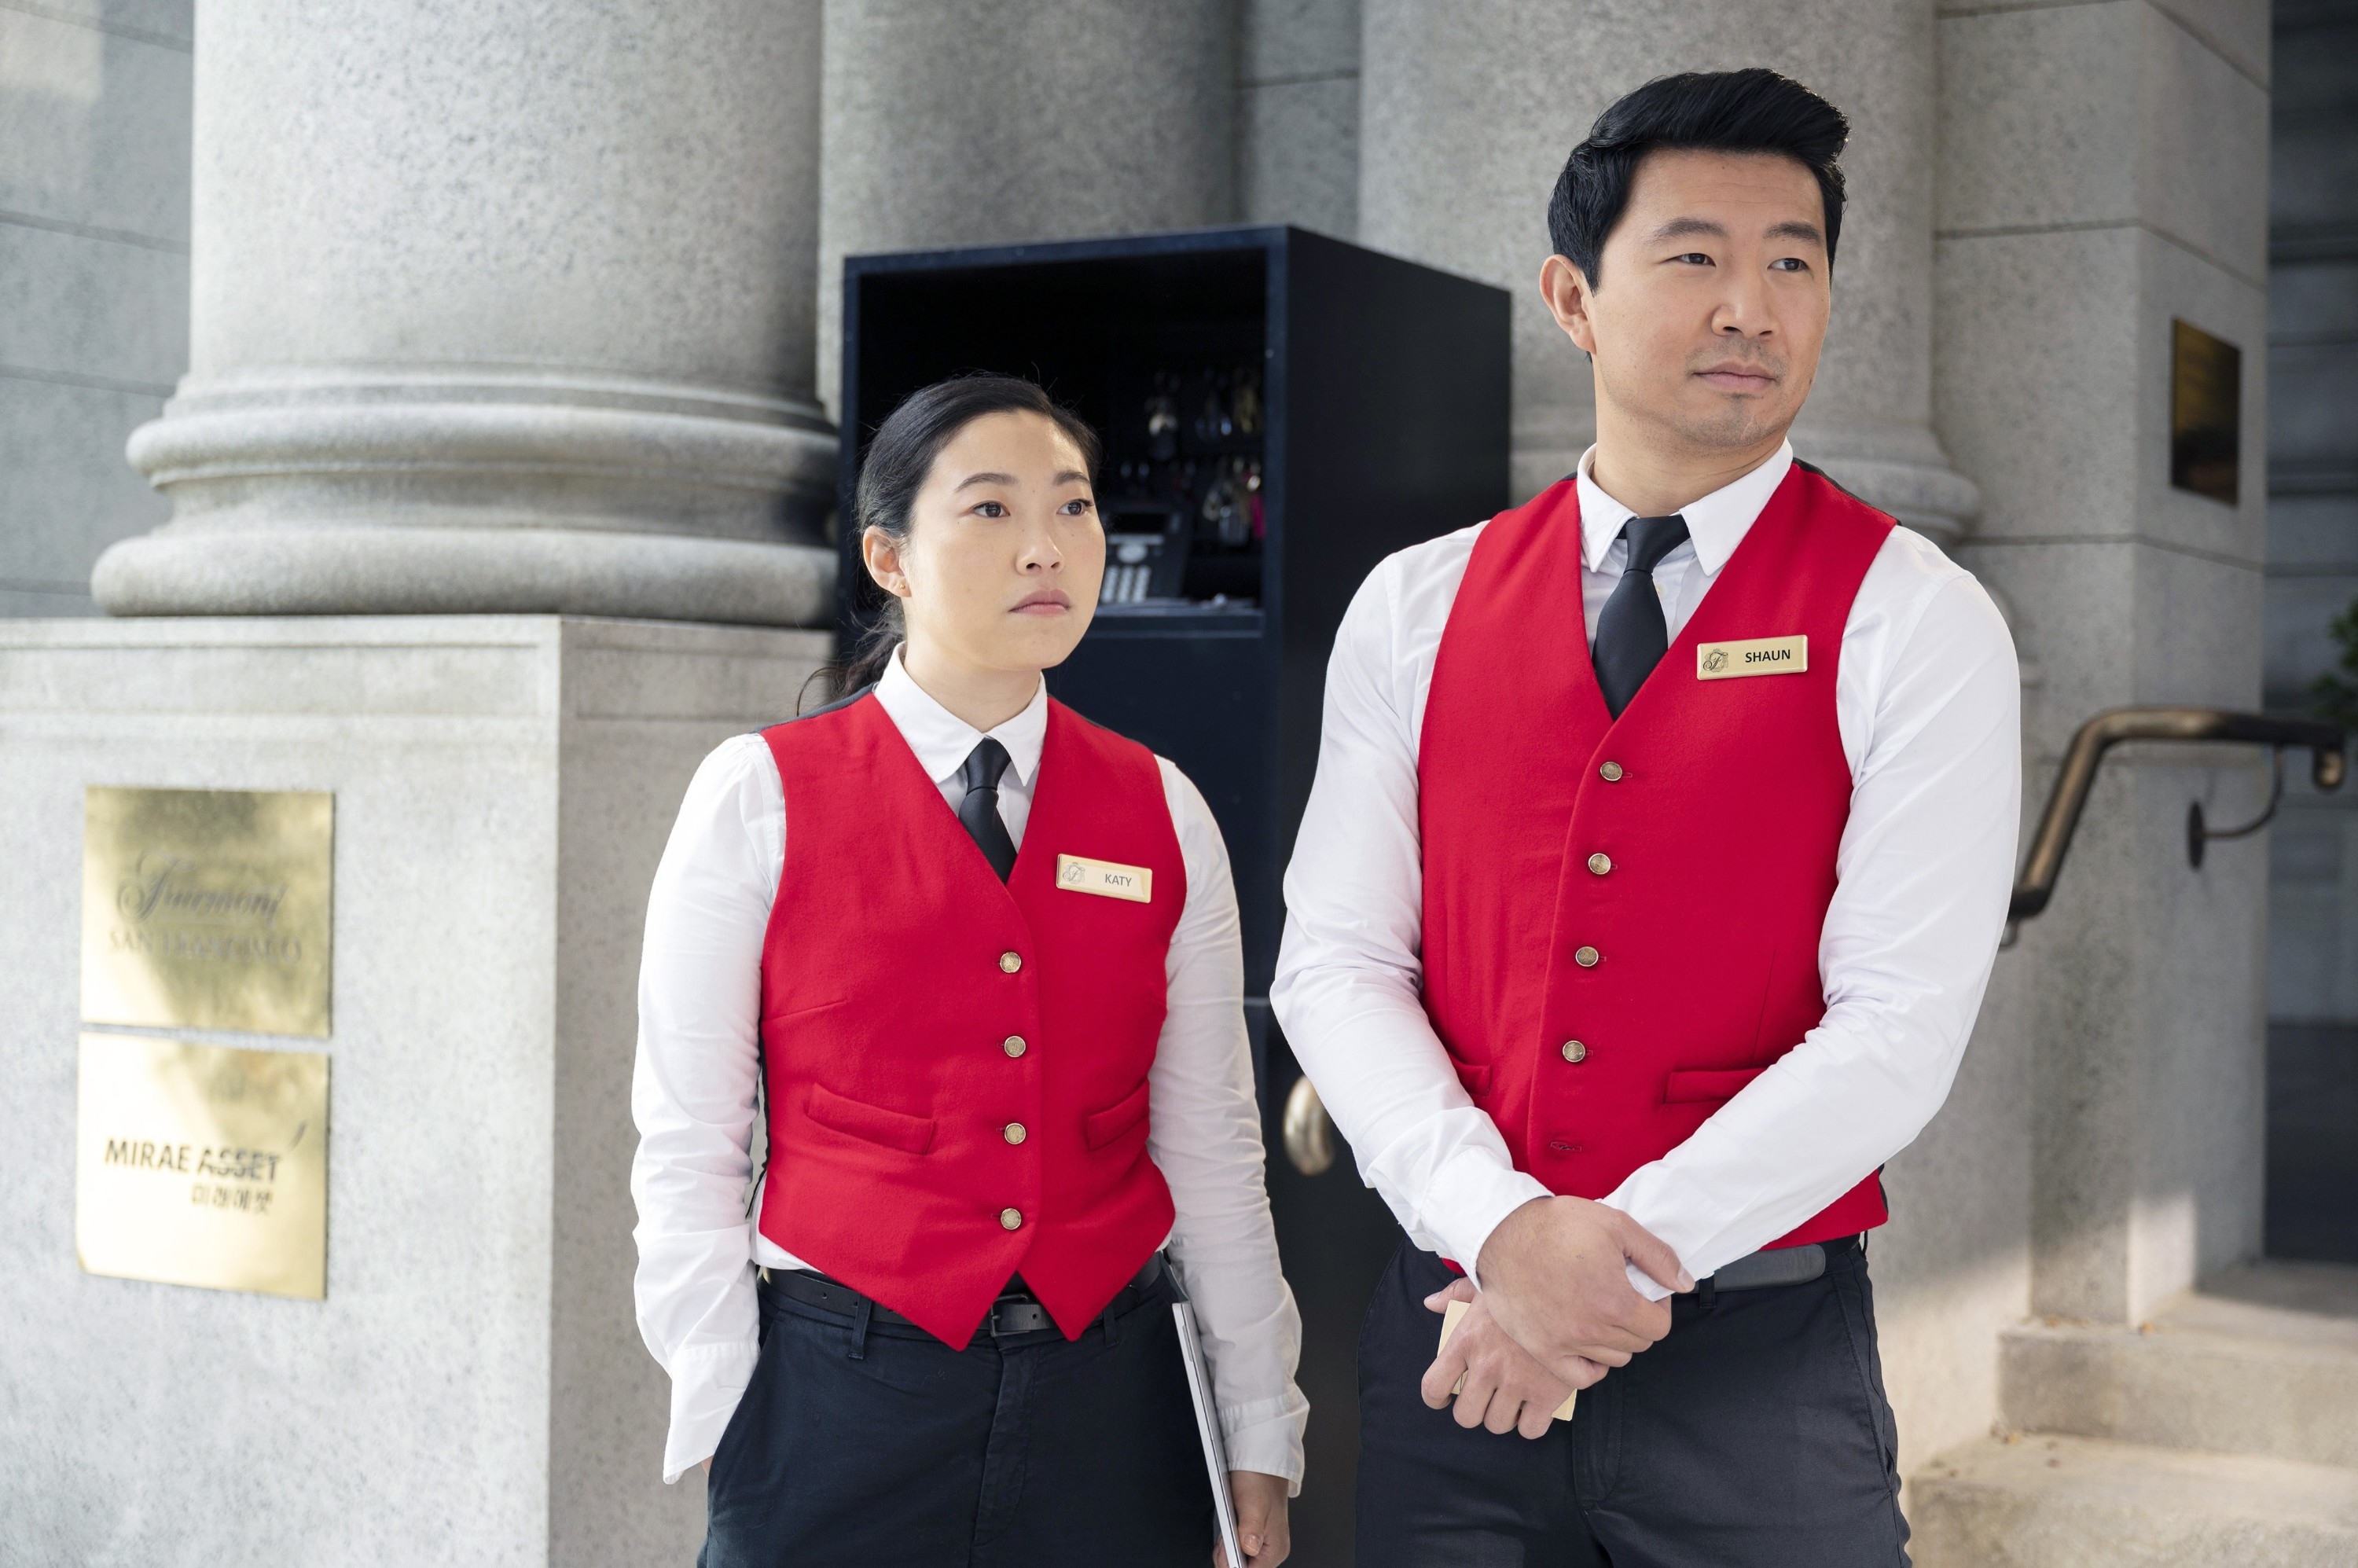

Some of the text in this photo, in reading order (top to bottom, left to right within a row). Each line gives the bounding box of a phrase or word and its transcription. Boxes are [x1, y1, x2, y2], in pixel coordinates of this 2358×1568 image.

[1745, 649, 1791, 663] SHAUN
[116, 847, 289, 930] Fairmont
[1104, 873, 1133, 887] KATY
[108, 929, 303, 964] SAN FRANCISCO
[105, 1137, 282, 1183] MIRAE ASSET
